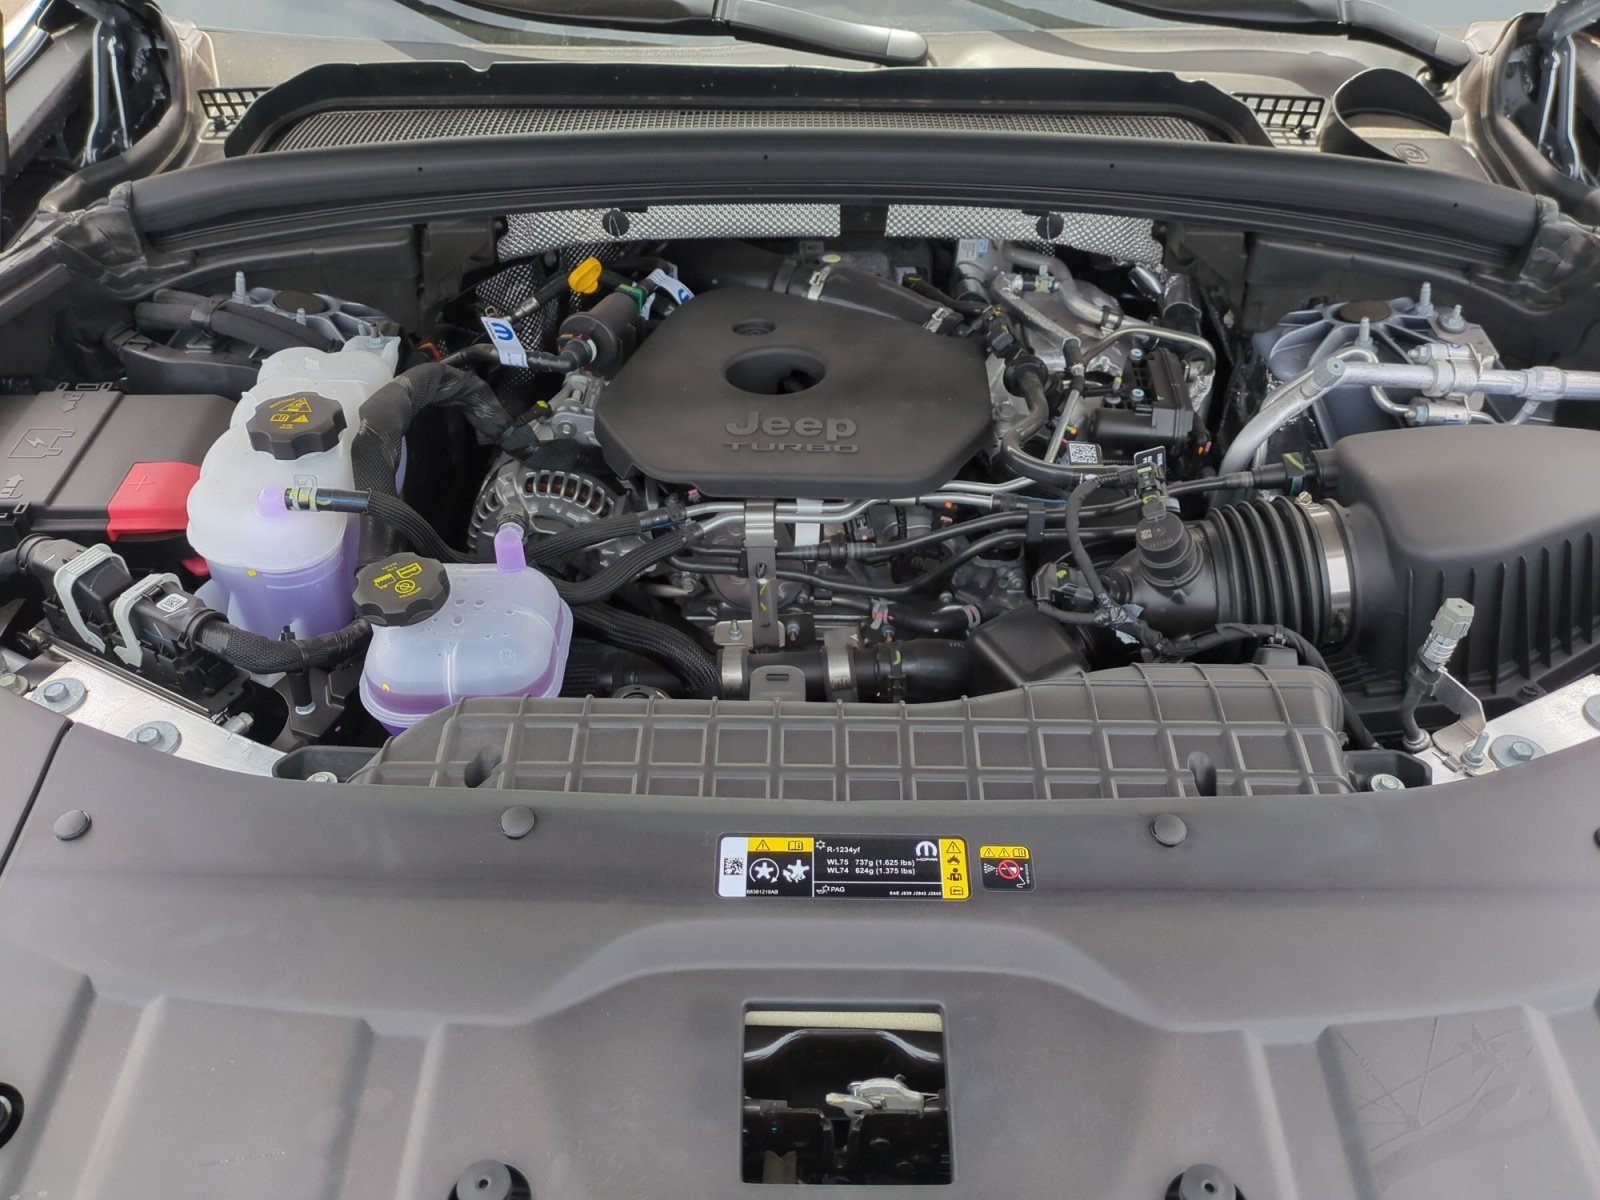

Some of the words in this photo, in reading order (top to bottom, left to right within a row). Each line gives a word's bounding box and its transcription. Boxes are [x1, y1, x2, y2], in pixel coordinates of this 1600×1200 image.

[725, 411, 857, 442] Jeep
[723, 442, 859, 453] TURBO
[826, 846, 861, 854] R-1234yf
[855, 859, 874, 867] 737g
[875, 859, 899, 868] (1.625
[900, 859, 916, 868] lbs)
[855, 867, 874, 875] 624g
[875, 867, 899, 876] (1.375
[900, 868, 916, 876] lbs)
